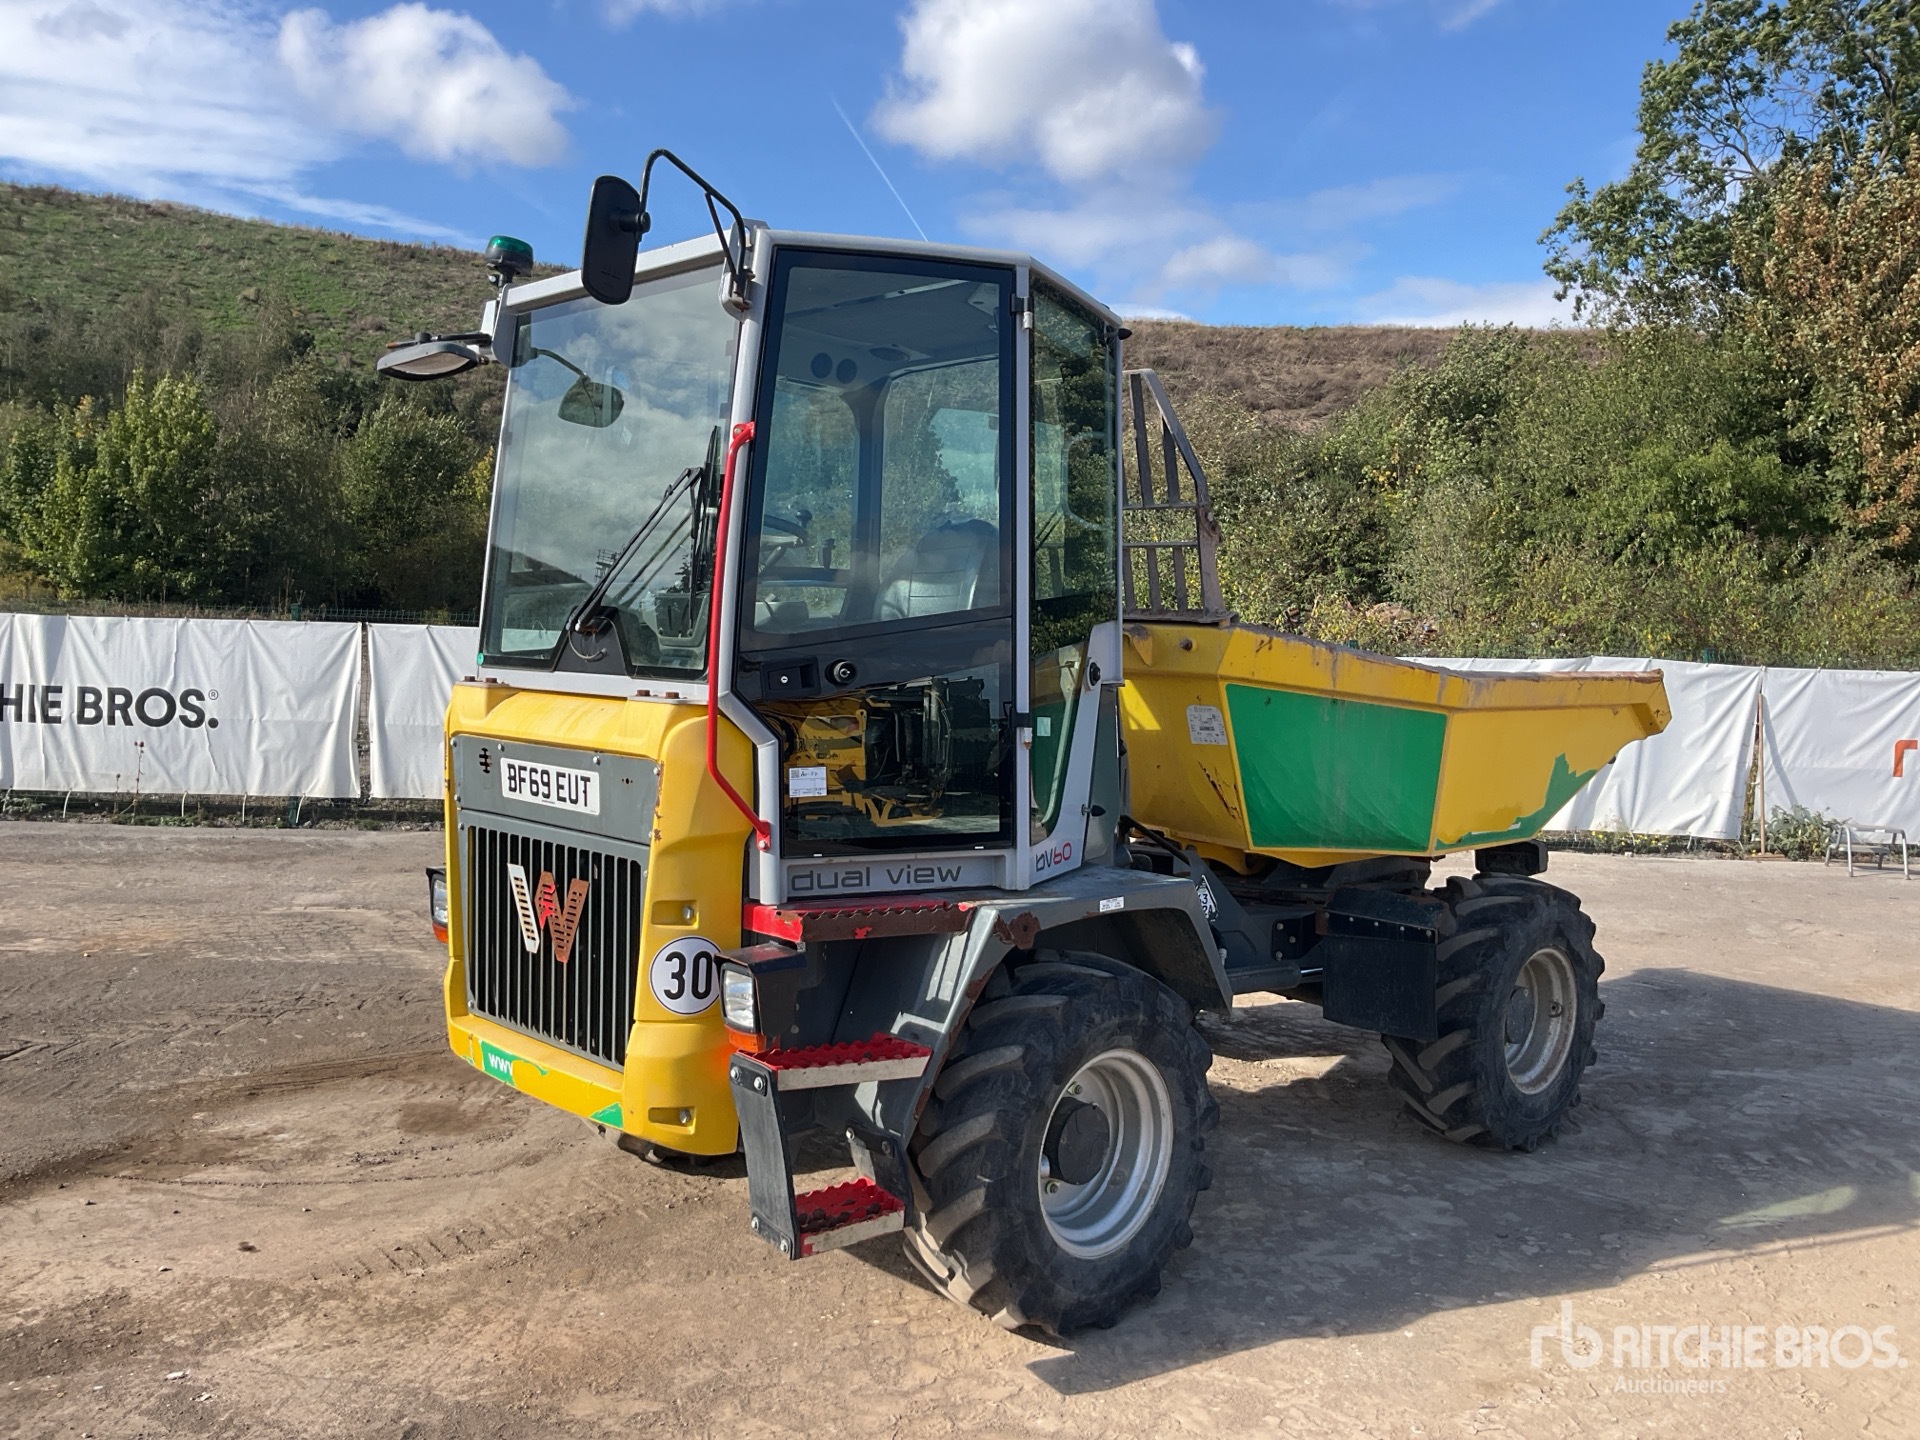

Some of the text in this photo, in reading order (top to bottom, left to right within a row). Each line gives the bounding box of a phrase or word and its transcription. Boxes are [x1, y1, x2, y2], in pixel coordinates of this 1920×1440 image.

[0, 683, 62, 725] HIE
[507, 763, 591, 807] BF69 EUT
[791, 864, 963, 892] dual view
[664, 951, 713, 1001] 30
